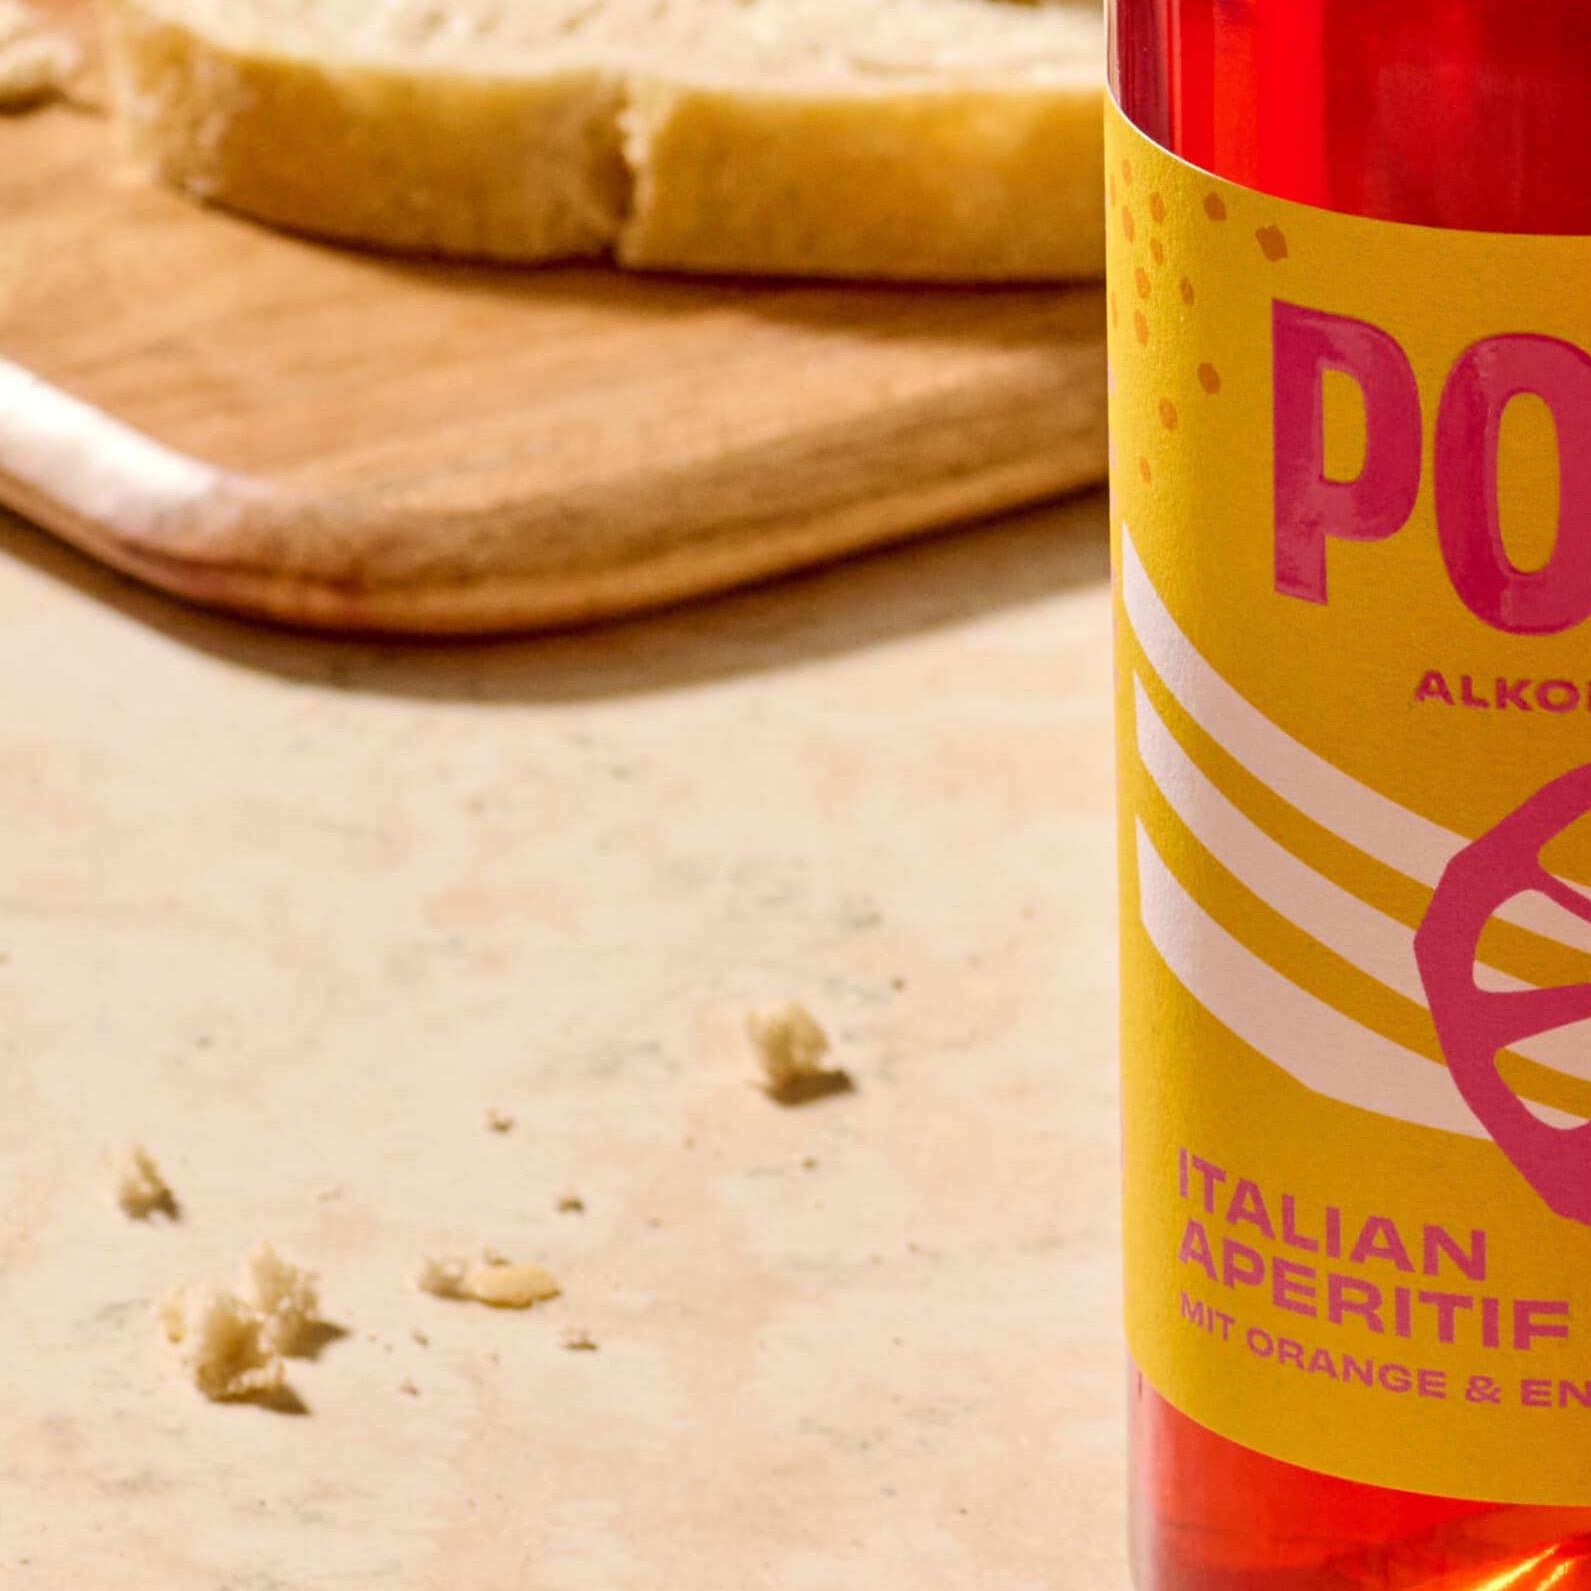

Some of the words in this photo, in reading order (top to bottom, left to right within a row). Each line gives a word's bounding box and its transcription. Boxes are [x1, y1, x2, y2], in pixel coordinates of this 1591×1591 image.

[1178, 1146, 1488, 1282] ITALIAN
[1177, 1217, 1570, 1351] APERITIF
[1180, 1291, 1235, 1343] MIT
[1245, 1327, 1447, 1400] ORANGE
[1464, 1374, 1502, 1404] &
